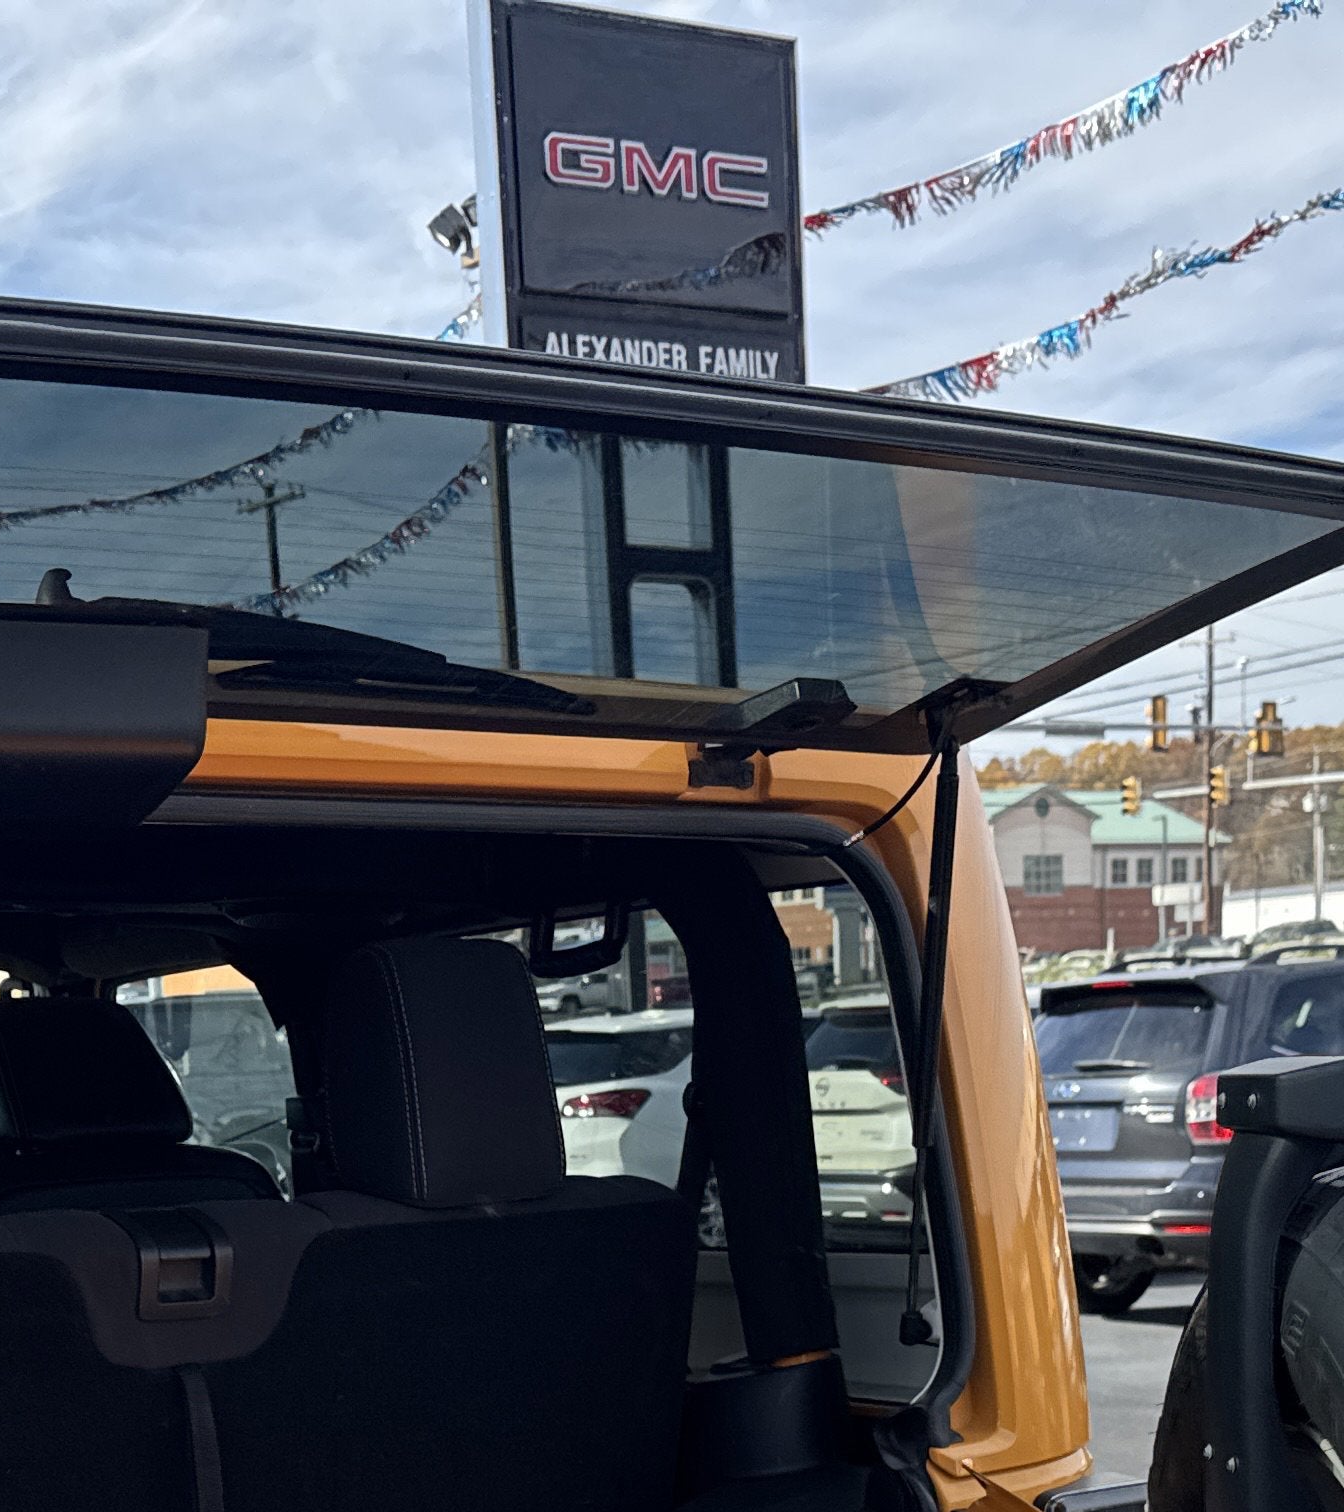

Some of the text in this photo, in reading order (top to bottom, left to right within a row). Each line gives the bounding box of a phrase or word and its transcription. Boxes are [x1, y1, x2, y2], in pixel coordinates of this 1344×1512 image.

[544, 131, 770, 208] GMC
[545, 331, 779, 380] ALEXANDER FAMILY
